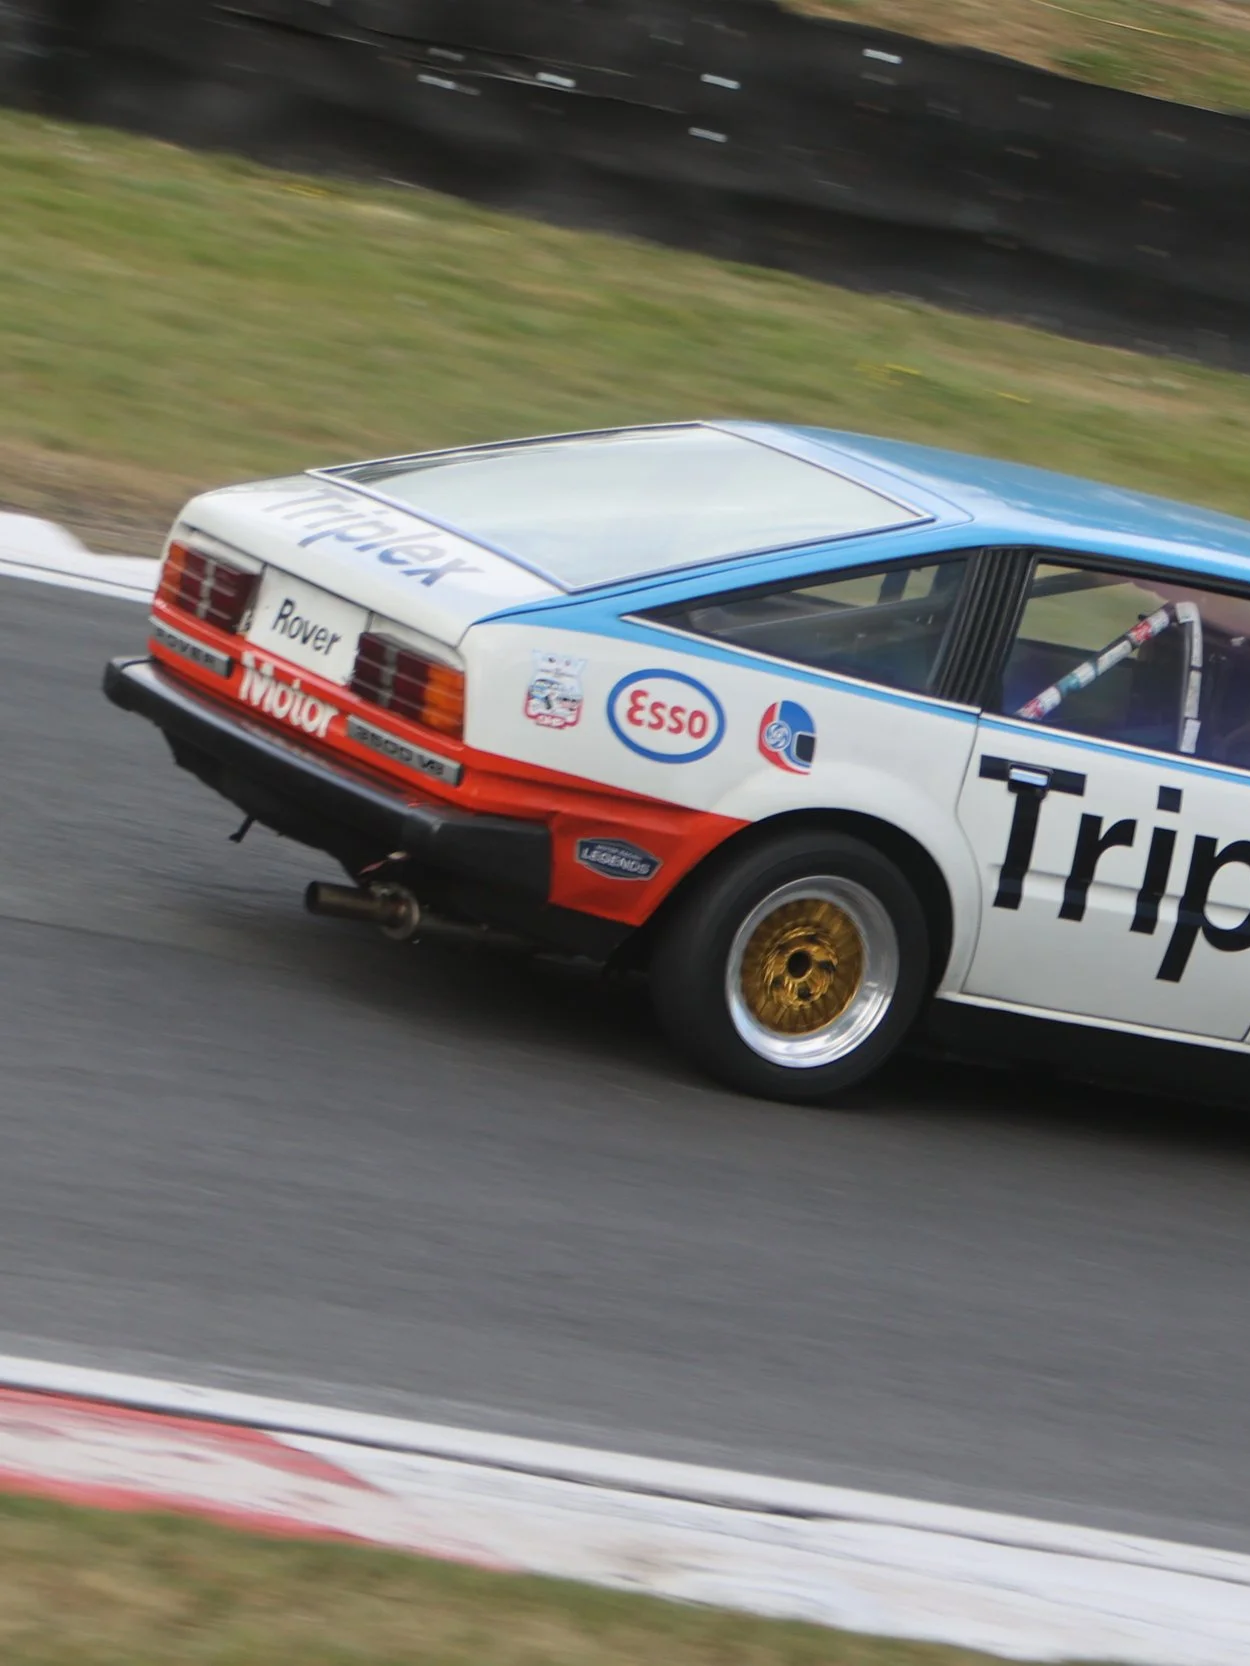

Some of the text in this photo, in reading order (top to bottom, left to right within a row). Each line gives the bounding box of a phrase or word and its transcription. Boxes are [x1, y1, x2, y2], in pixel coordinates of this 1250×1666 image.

[261, 488, 485, 588] Triplex
[272, 598, 343, 655] Rover
[238, 651, 339, 738] Motor
[581, 847, 652, 876] LEGENDS
